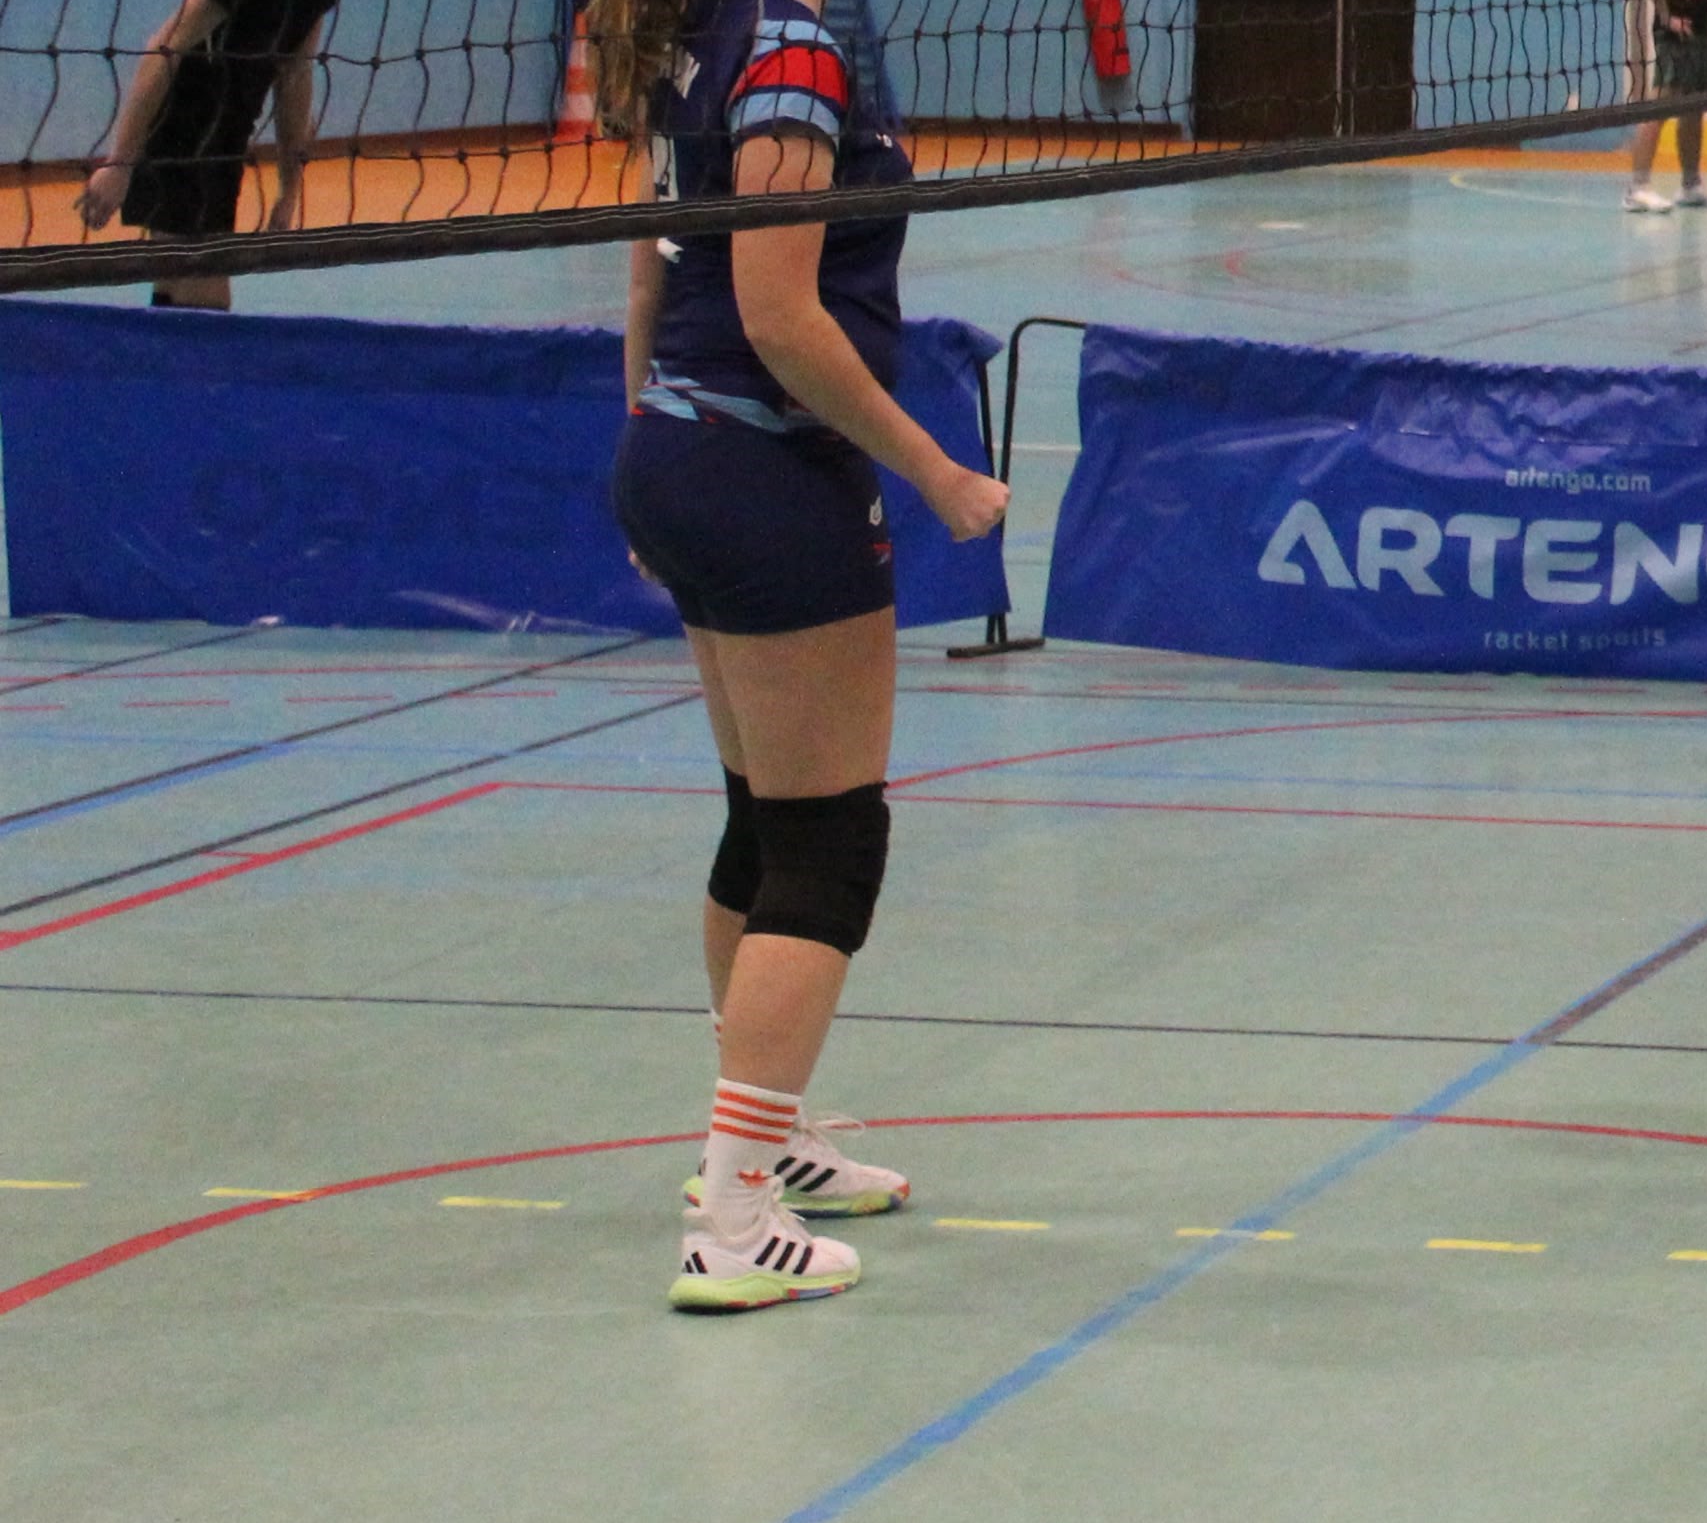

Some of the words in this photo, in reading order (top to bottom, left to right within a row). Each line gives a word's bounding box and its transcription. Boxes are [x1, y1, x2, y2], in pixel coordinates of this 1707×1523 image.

[1505, 467, 1651, 495] artengo.com
[1484, 631, 1568, 650] racket
[1578, 629, 1665, 651] sports
